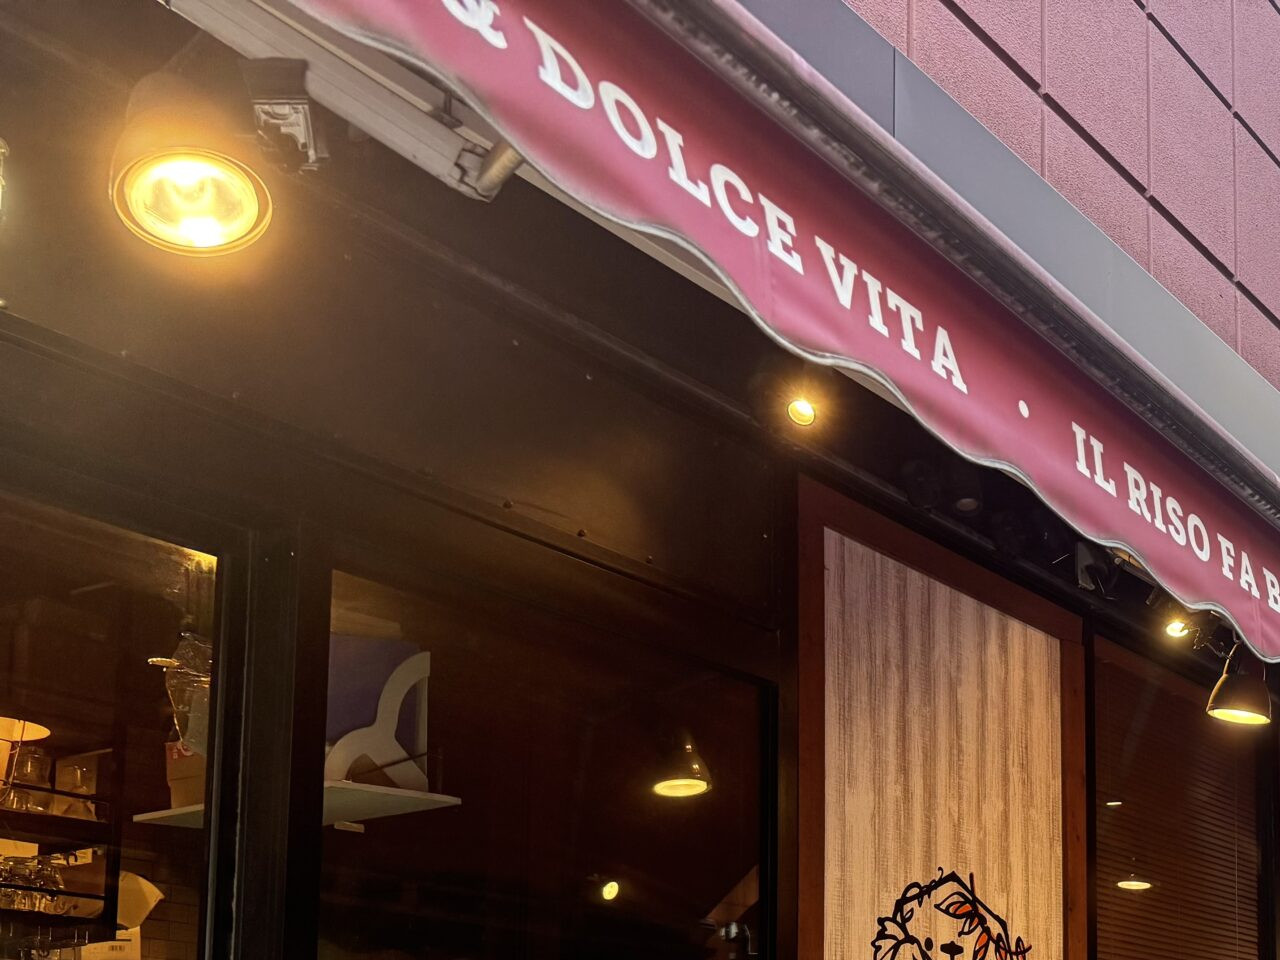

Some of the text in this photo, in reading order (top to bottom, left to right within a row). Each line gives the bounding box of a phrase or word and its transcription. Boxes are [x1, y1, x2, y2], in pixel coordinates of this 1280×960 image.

[523, 16, 804, 274] DOLCE
[815, 236, 968, 394] VITA
[1071, 422, 1117, 498] IL
[1124, 462, 1210, 562] RISO
[1217, 533, 1260, 599] FA
